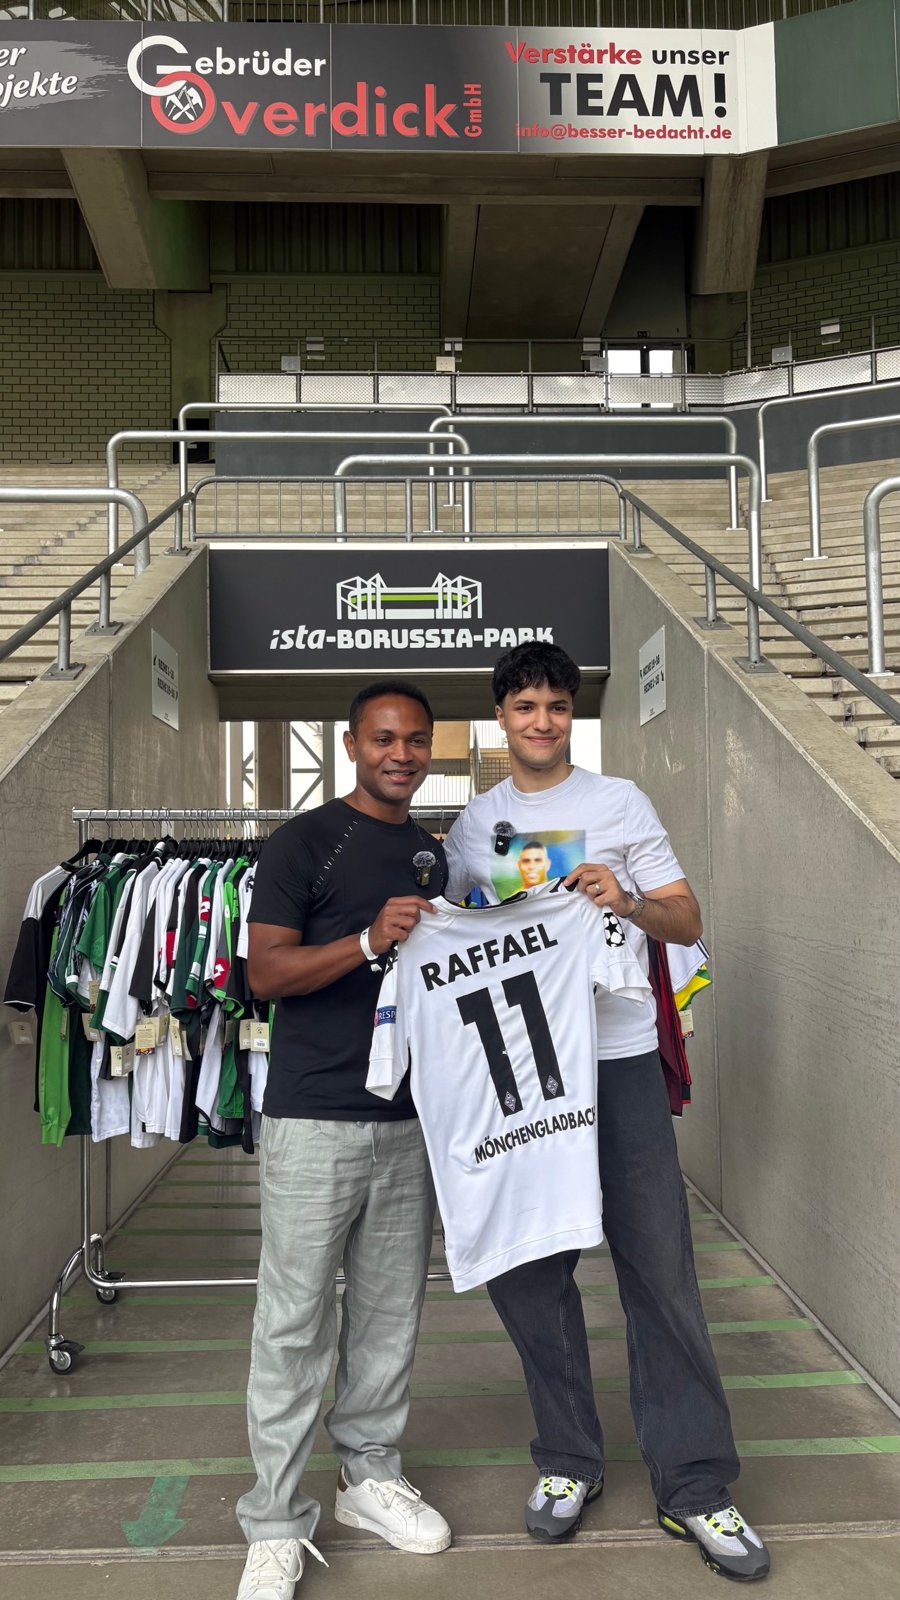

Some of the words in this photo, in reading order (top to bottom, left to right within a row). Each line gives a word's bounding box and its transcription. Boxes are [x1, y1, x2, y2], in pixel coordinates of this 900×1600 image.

[127, 34, 327, 97] Gebrüder
[504, 41, 642, 66] Verstärke
[651, 48, 730, 66] unser
[463, 82, 483, 138] GmbH
[540, 72, 727, 118] TEAM!
[515, 122, 732, 141] info@besser-bedacht.de
[269, 624, 554, 650] ista-BORUSSIA-PARK
[420, 923, 558, 991] RAFFAEL
[455, 970, 565, 1117] 11
